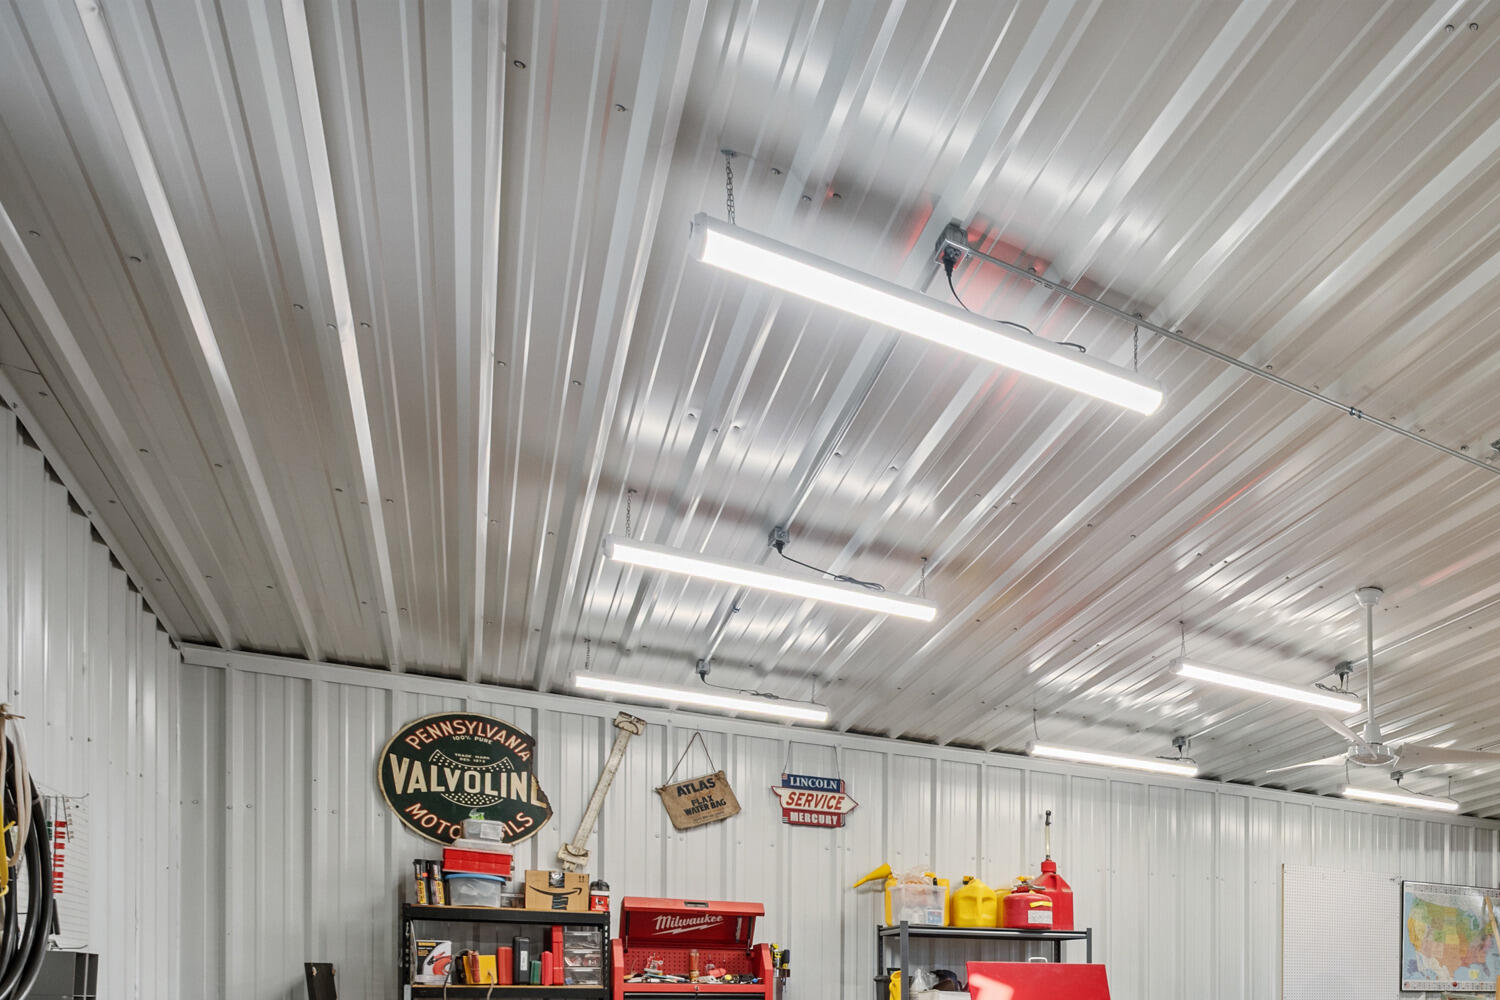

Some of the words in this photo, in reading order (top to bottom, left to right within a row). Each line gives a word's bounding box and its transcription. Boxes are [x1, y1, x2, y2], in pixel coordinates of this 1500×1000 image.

[405, 719, 531, 762] PENNSYLVANIA
[474, 736, 493, 745] PURE
[677, 778, 716, 797] ATLAS
[790, 776, 838, 790] LINCOLN
[684, 803, 709, 816] WATER
[711, 799, 726, 809] BAG
[691, 795, 714, 806] FLAX
[785, 791, 845, 810] SERVICE
[405, 802, 462, 839] MOTO
[502, 812, 534, 837] ILS
[790, 811, 838, 825] MERCURY
[653, 914, 724, 931] Milwaukee
